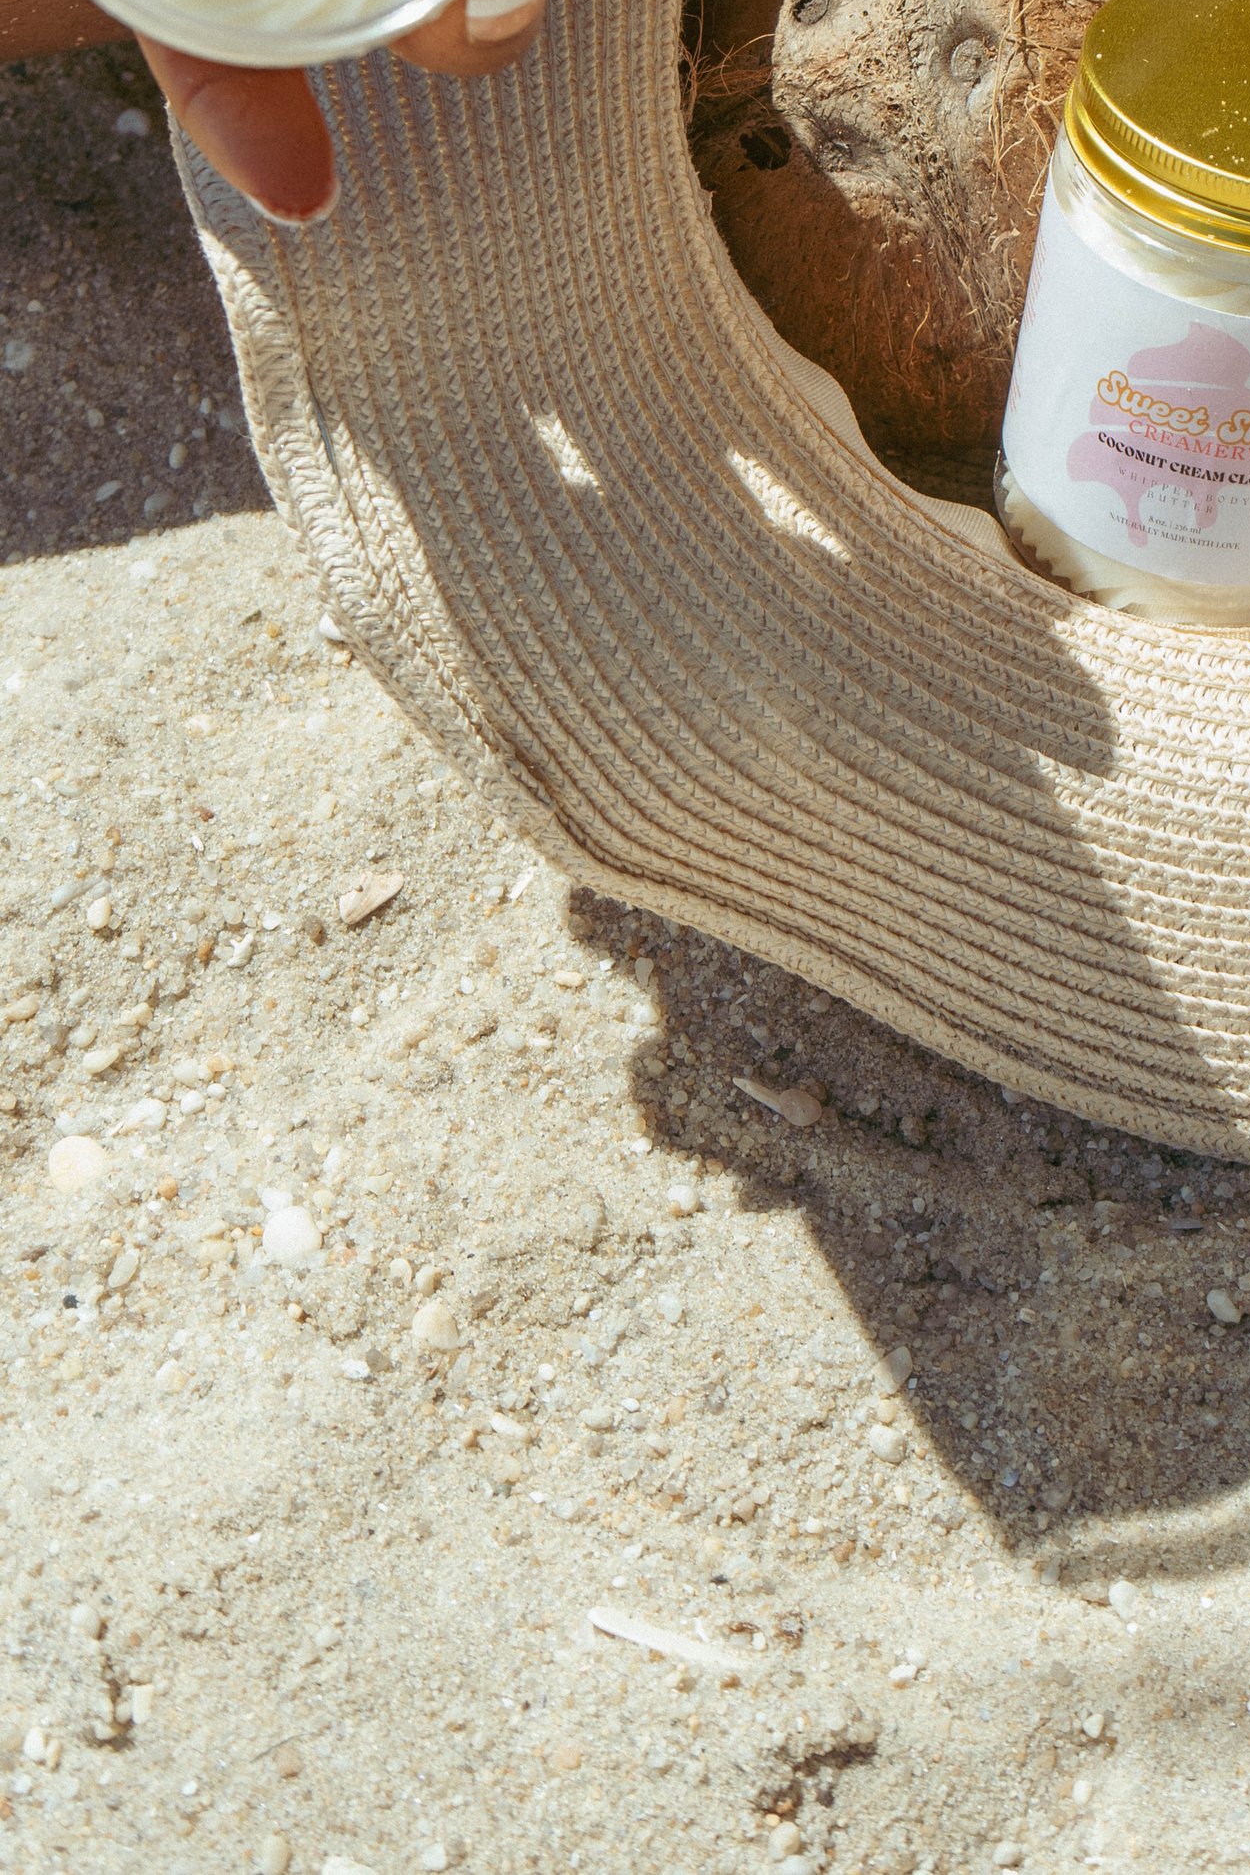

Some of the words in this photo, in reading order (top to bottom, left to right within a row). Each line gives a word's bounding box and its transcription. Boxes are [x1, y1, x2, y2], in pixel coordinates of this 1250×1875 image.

[1097, 370, 1210, 436] Sweet
[1098, 431, 1167, 469] COCONUT
[1170, 461, 1225, 483] CREAM
[1118, 466, 1194, 498] WHIPPED
[1206, 493, 1250, 506] BODY
[1147, 491, 1214, 514] BUTTER
[1109, 511, 1159, 536] NATURALLY
[1160, 530, 1187, 544] MADE
[1189, 536, 1215, 548] WITH
[1215, 541, 1241, 551] LOVE
